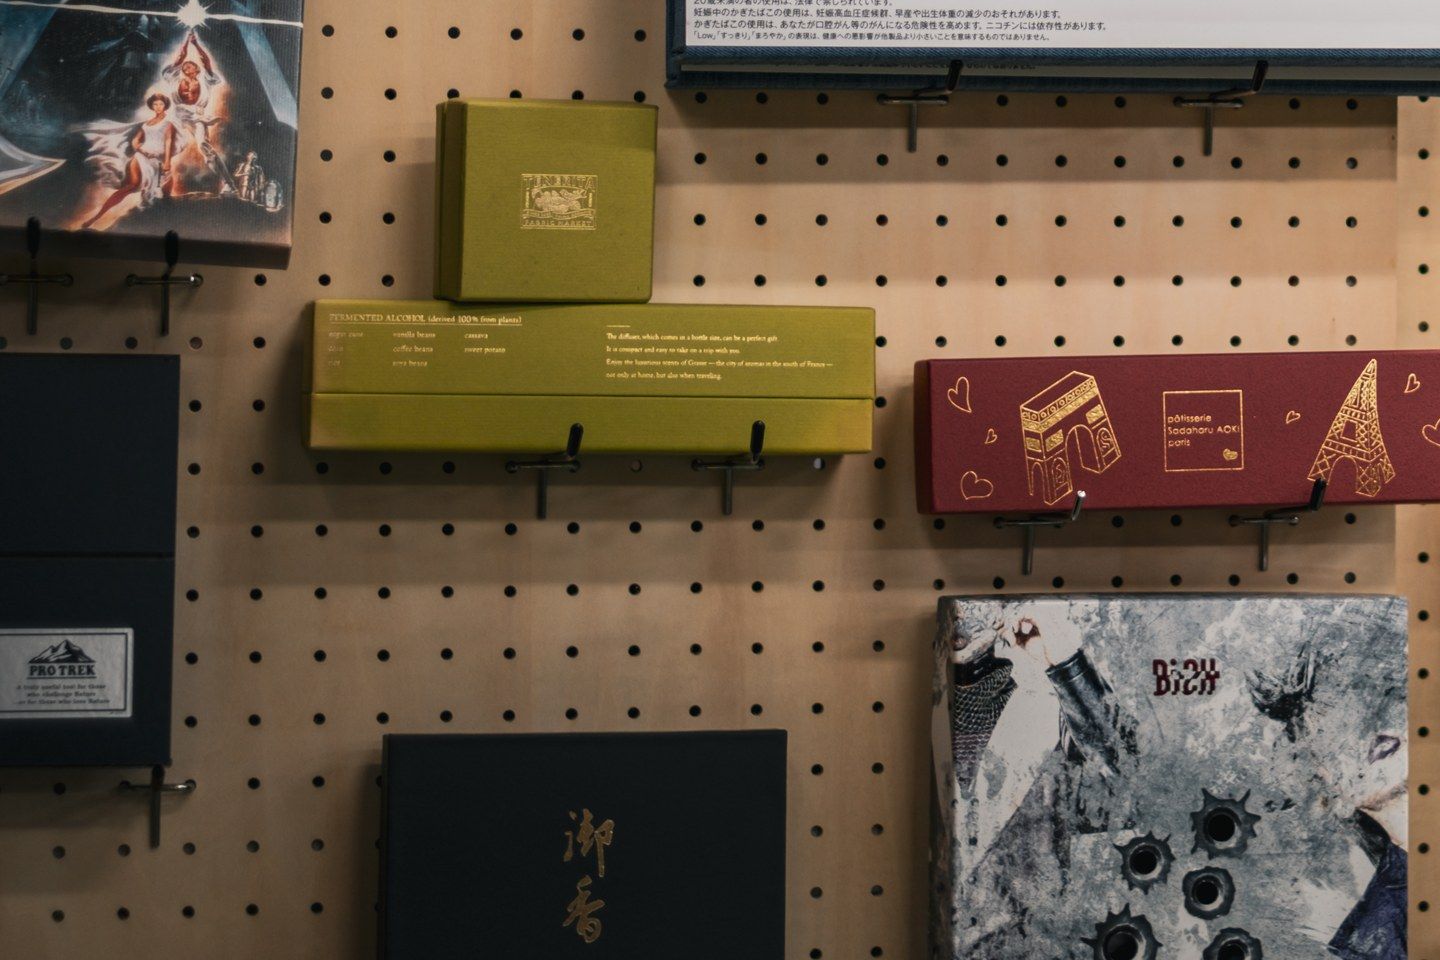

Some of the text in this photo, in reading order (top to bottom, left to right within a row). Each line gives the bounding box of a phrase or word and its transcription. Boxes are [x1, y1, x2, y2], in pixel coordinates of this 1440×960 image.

[329, 313, 522, 325] FERMENTED ALCOHOL (derived 100% from plants)
[606, 332, 617, 340] The
[1168, 425, 1240, 435] Sadaharu AOKI
[1168, 438, 1191, 448] paris
[29, 664, 95, 676] PRO TREK
